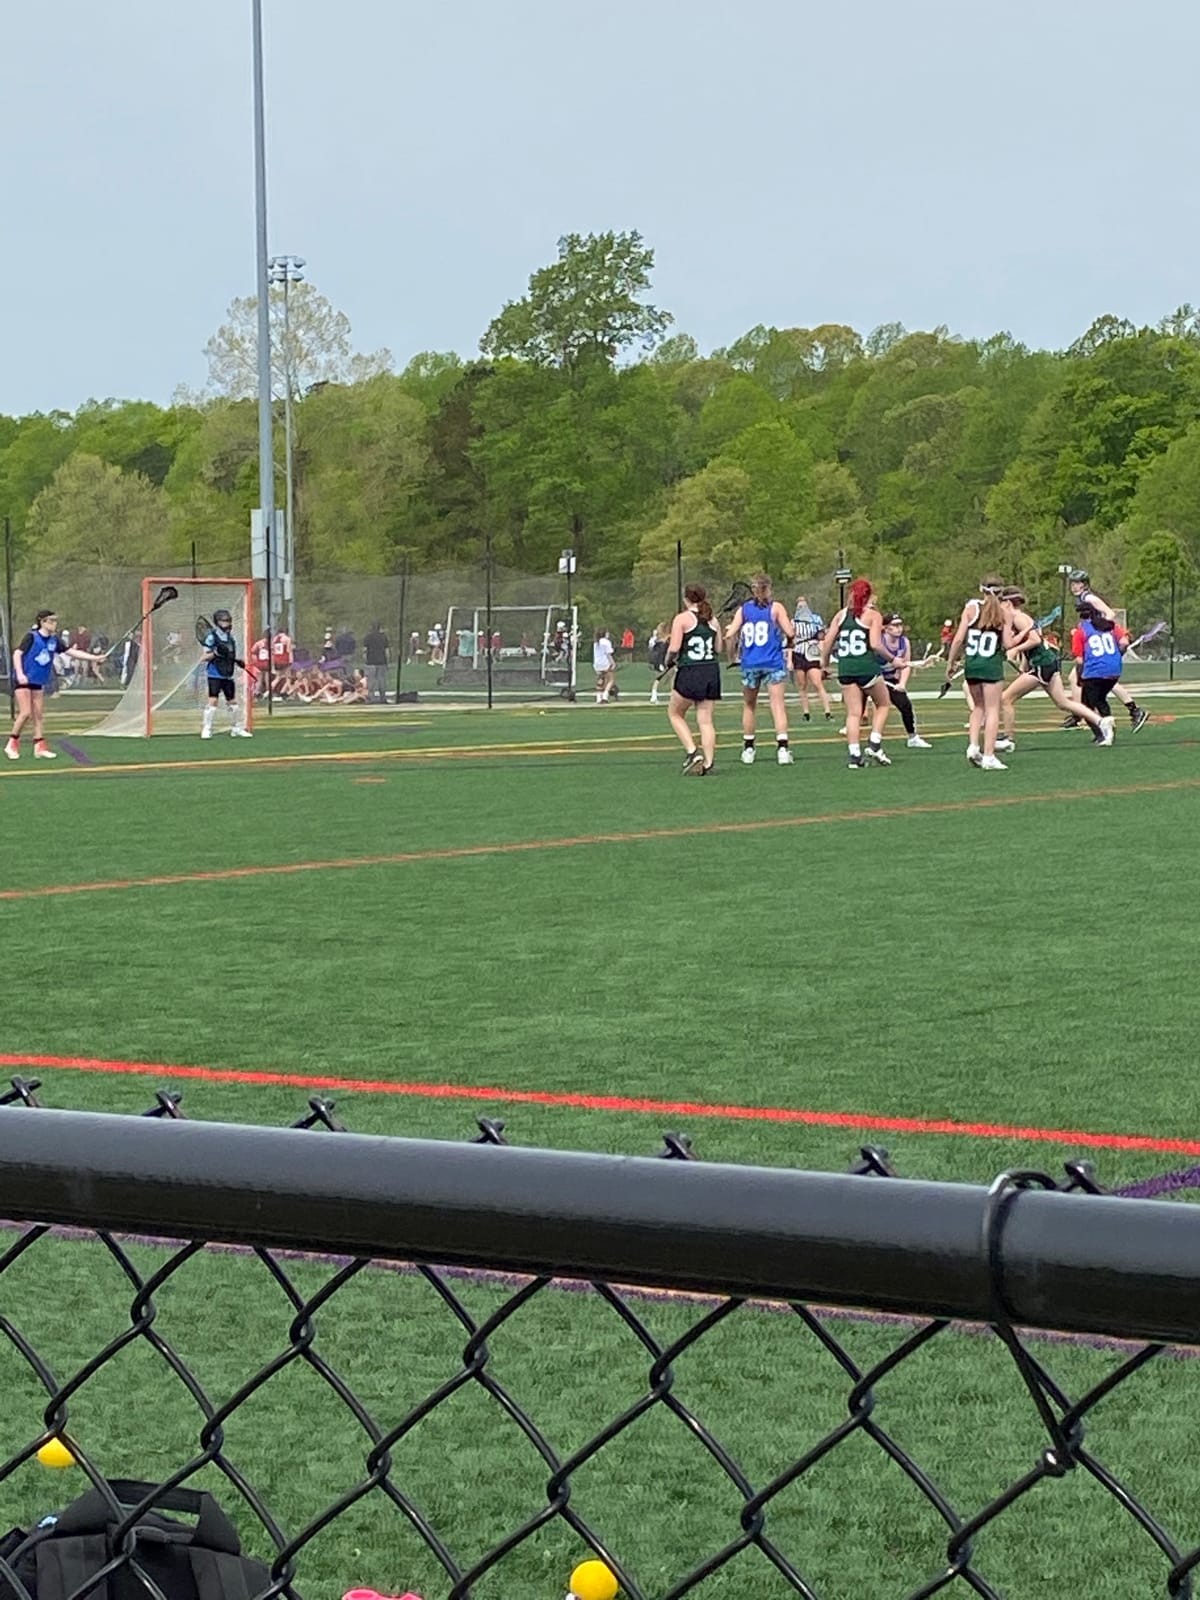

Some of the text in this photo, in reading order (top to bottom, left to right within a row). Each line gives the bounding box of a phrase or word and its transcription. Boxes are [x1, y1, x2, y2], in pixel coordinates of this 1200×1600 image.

[688, 636, 713, 660] 31
[837, 630, 867, 657] 56
[965, 630, 998, 657] 50
[1088, 633, 1115, 657] 90
